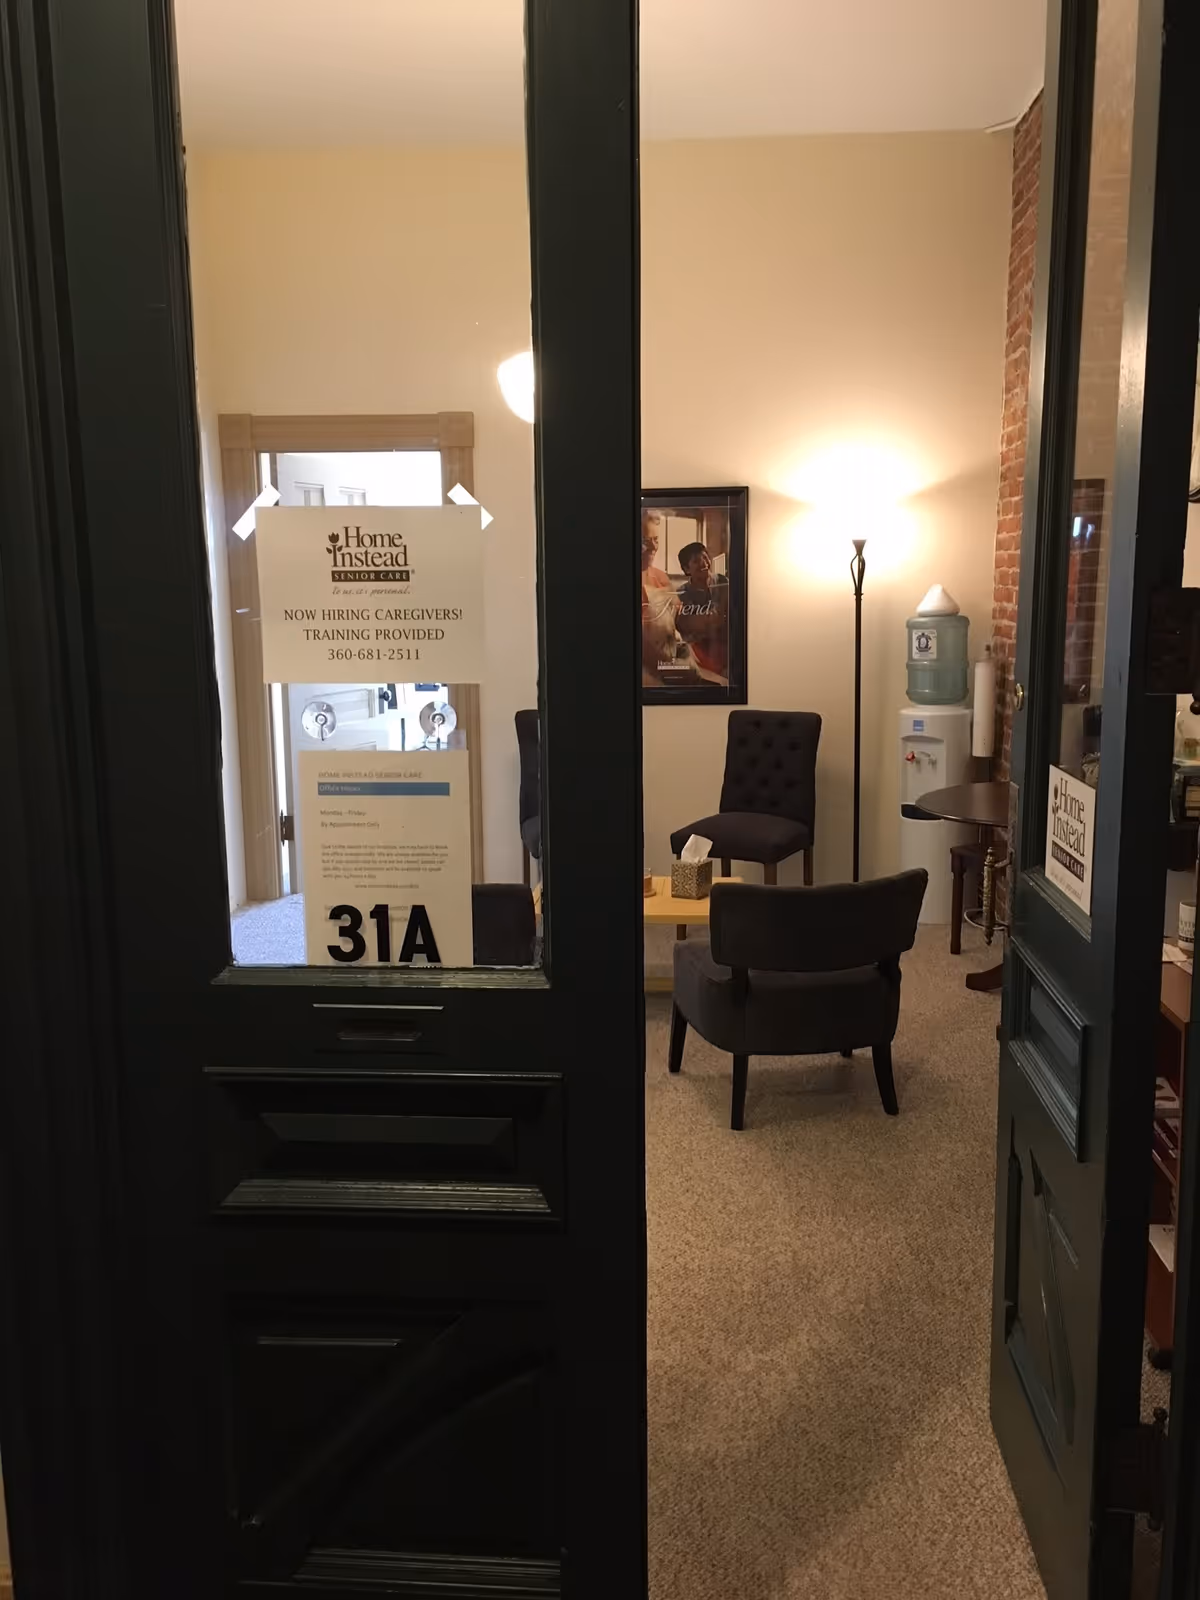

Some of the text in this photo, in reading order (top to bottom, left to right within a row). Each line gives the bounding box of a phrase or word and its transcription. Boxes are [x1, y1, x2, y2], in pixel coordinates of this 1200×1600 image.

[343, 526, 403, 548] Home
[331, 544, 410, 568] Instead
[334, 572, 408, 580] SENIOR CARE
[284, 608, 463, 621] NOW HIRING CAREGIVERS!
[303, 629, 445, 641] TRAINING PROVIDED
[328, 649, 421, 660] 360-681-2511
[318, 771, 340, 779] HOME
[403, 771, 423, 779] CARE
[319, 784, 340, 792] Office
[1059, 777, 1085, 824] Home
[1052, 802, 1086, 857] Instead
[327, 904, 441, 963] 31A
